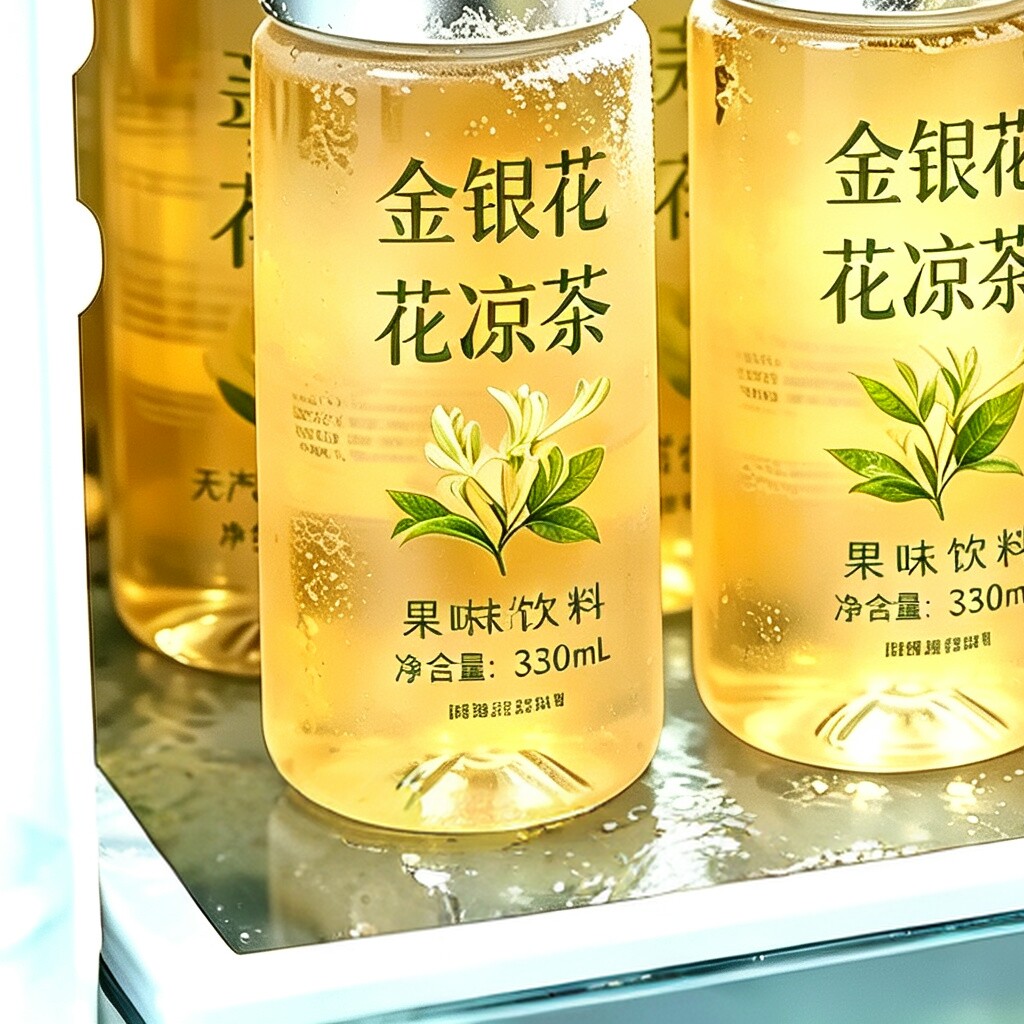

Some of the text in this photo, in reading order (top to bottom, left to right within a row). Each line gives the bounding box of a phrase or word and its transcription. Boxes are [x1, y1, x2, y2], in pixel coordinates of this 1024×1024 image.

[376, 146, 607, 244] 金银花
[375, 264, 610, 366] 花凉茶
[515, 636, 611, 677] 330mL
